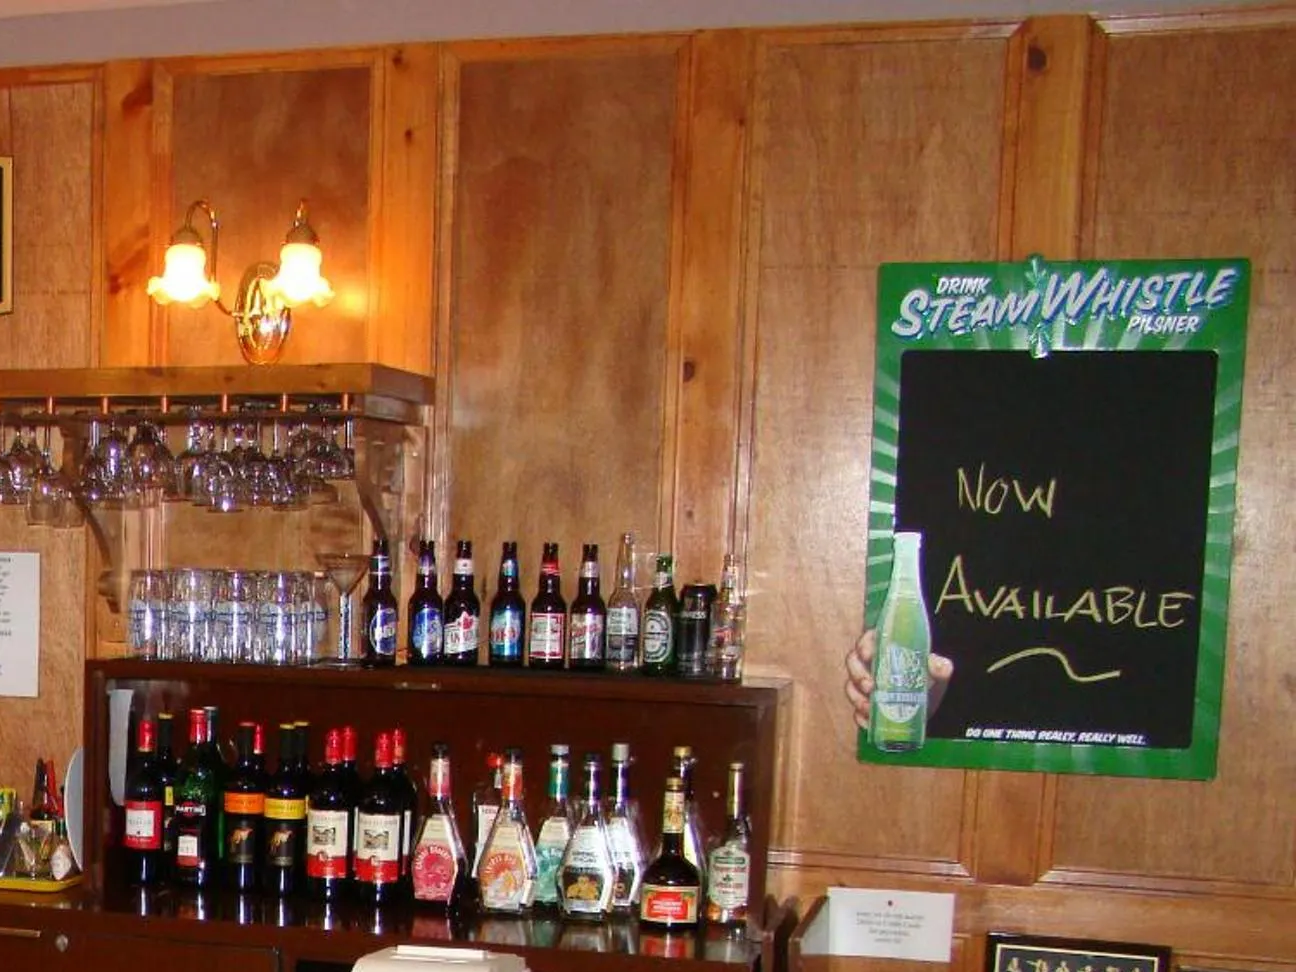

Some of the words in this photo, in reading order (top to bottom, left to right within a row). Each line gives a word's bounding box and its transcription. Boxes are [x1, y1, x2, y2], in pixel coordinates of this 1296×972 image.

[936, 276, 992, 296] DRINK
[891, 288, 1040, 339] STEAM
[1042, 267, 1238, 326] WHISTLE
[1126, 314, 1202, 333] PILSNER
[934, 554, 1196, 630] AVAILABLE
[965, 727, 980, 738] DO
[982, 728, 1003, 739] ONE
[1005, 729, 1037, 741] THING
[1077, 731, 1116, 744] REALLY
